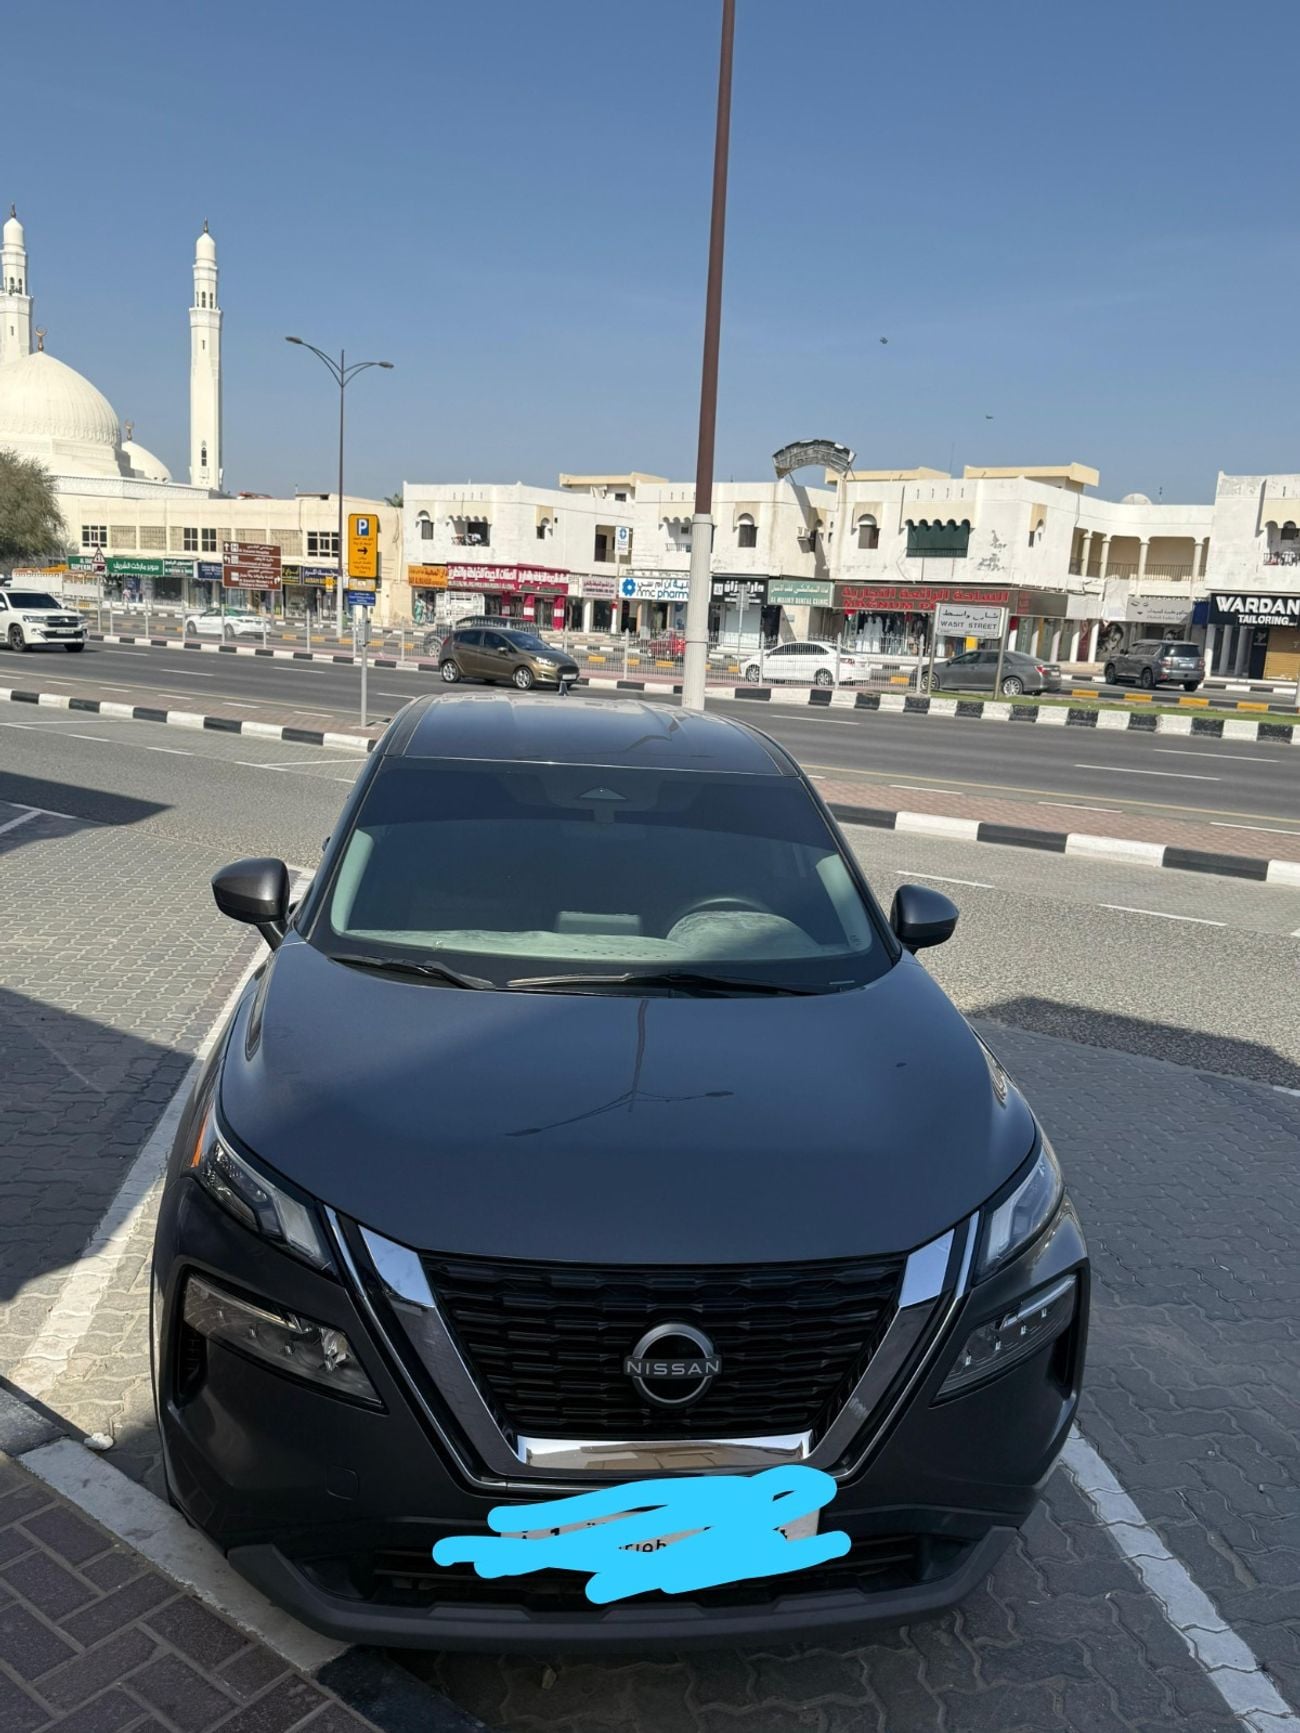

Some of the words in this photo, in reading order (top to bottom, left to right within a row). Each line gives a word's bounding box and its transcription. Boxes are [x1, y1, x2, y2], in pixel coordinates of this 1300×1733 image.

[636, 588, 656, 598] nmc
[657, 590, 690, 601] pharm
[842, 599, 914, 610] MAGNUM
[1215, 596, 1300, 616] WARDAN
[942, 609, 971, 620] واسط
[1238, 614, 1289, 626] TAILORING
[940, 620, 965, 628] WASIT
[968, 621, 998, 630] STREET
[626, 1360, 720, 1376] NISSAN
